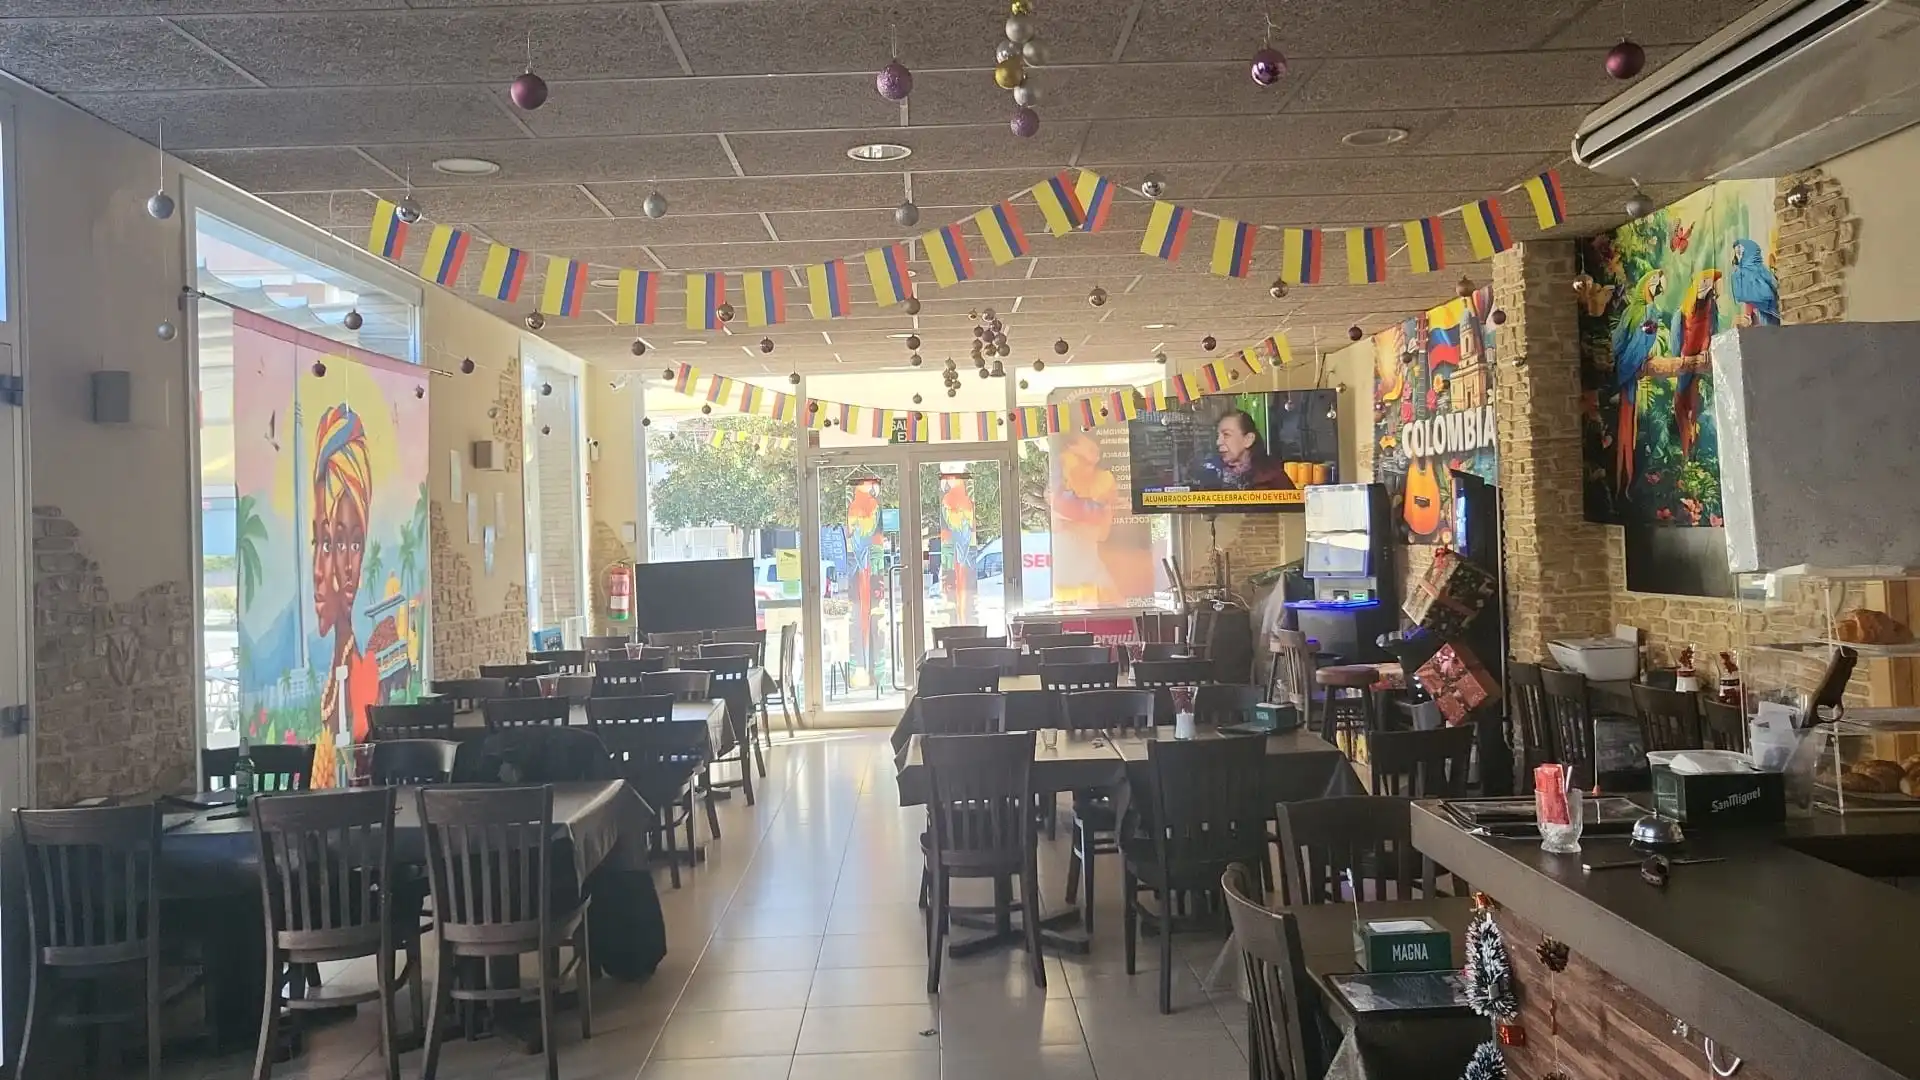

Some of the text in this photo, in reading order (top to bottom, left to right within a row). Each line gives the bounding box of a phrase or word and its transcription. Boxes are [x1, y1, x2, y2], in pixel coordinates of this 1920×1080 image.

[892, 420, 908, 431] SAL
[1402, 405, 1496, 458] COLOMBIA
[1144, 495, 1191, 503] ALUMBRADOS
[1193, 494, 1211, 502] PARA
[1212, 492, 1261, 502] CELEBRACIÓN
[1392, 943, 1429, 962] MAGNA
